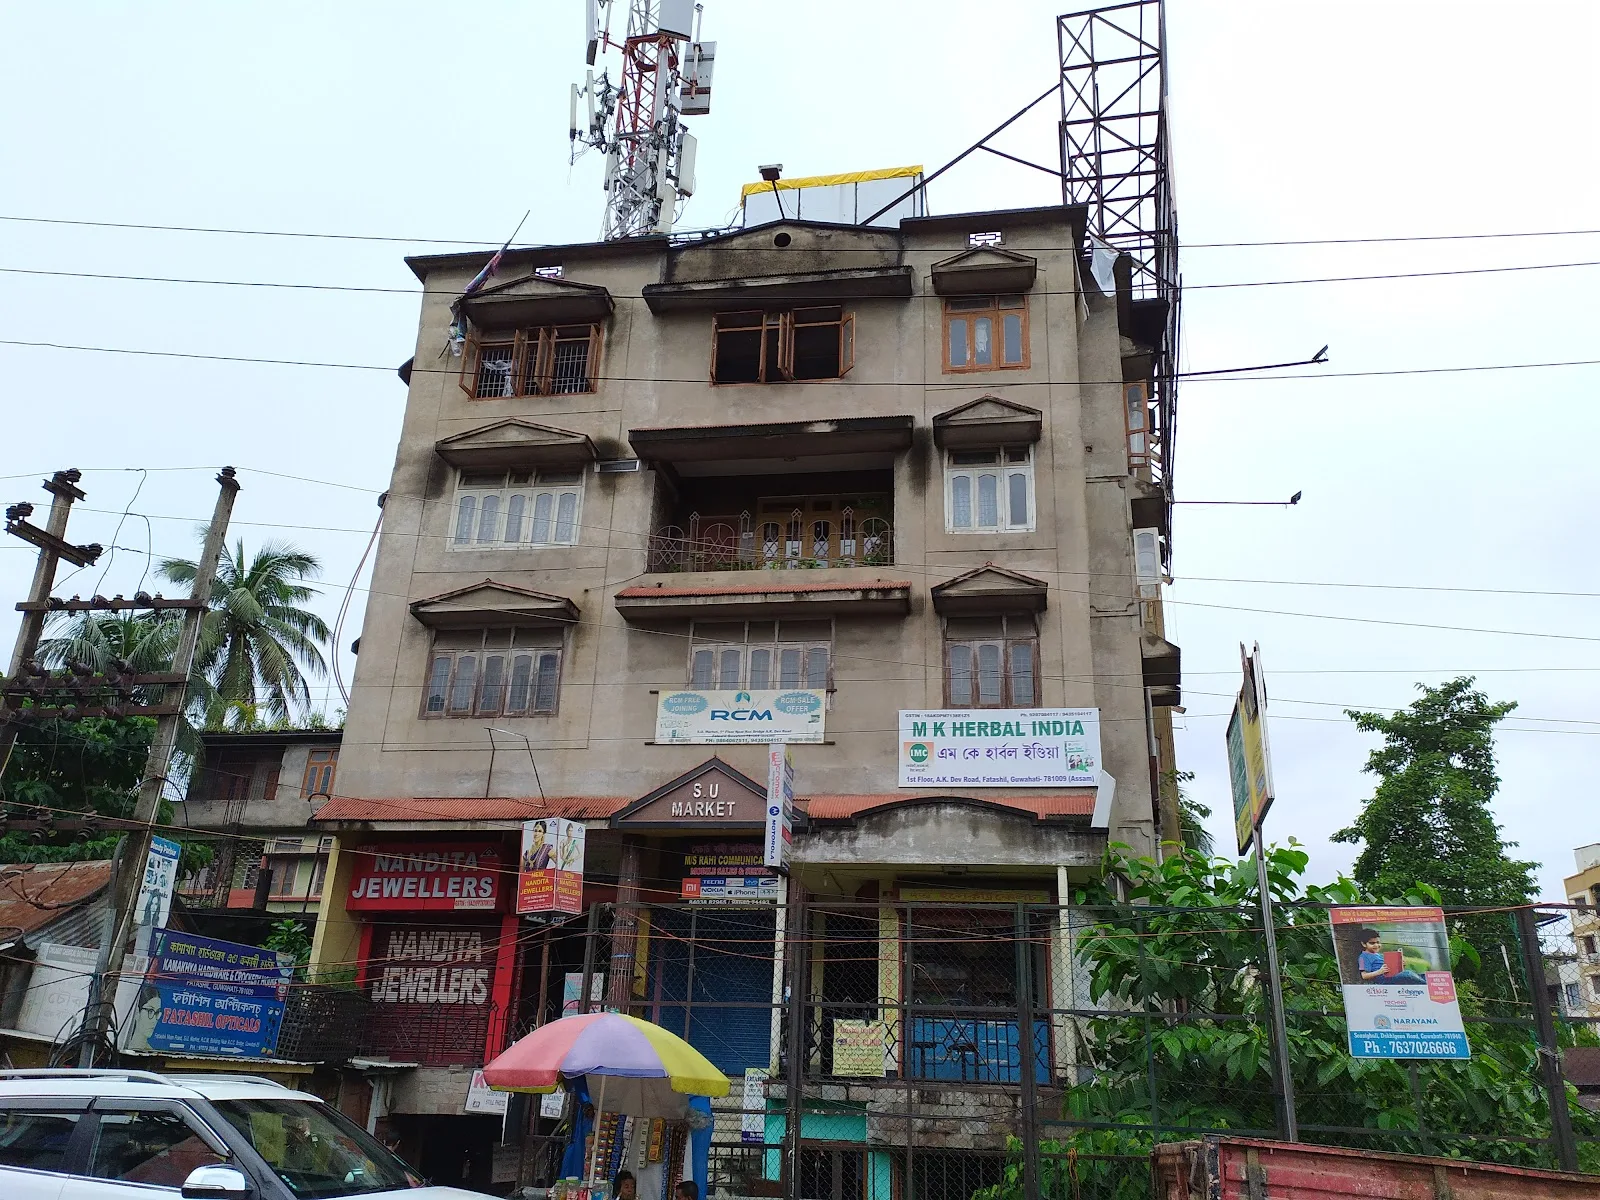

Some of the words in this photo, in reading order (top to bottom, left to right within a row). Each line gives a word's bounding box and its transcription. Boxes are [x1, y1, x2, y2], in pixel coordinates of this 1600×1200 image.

[710, 709, 773, 721] RCM
[912, 721, 927, 737] M
[933, 721, 946, 737] K
[952, 721, 1026, 737] HERBAL
[1032, 720, 1085, 736] INDIA
[910, 749, 928, 757] IMC
[938, 747, 957, 760] এম
[963, 747, 980, 760] কে
[1068, 775, 1095, 783] (Assam)
[671, 801, 736, 817] MARKET
[373, 852, 478, 872] NANDITA
[718, 855, 765, 865] COMMUNICA
[531, 870, 545, 878] NEW
[351, 876, 493, 898] JEWELLERS
[525, 878, 550, 887] NANDITA
[520, 885, 554, 895] JEWELLERS
[733, 888, 756, 896] iPhone
[386, 931, 482, 962] NANDITA
[163, 958, 198, 975] KAMAKHYA
[371, 967, 489, 1005] JEWELLERS
[162, 1007, 214, 1029] FATASHIL
[215, 1013, 261, 1033] OPTICALS
[1363, 1040, 1380, 1054] Ph
[1389, 1041, 1457, 1055] 7637026666
